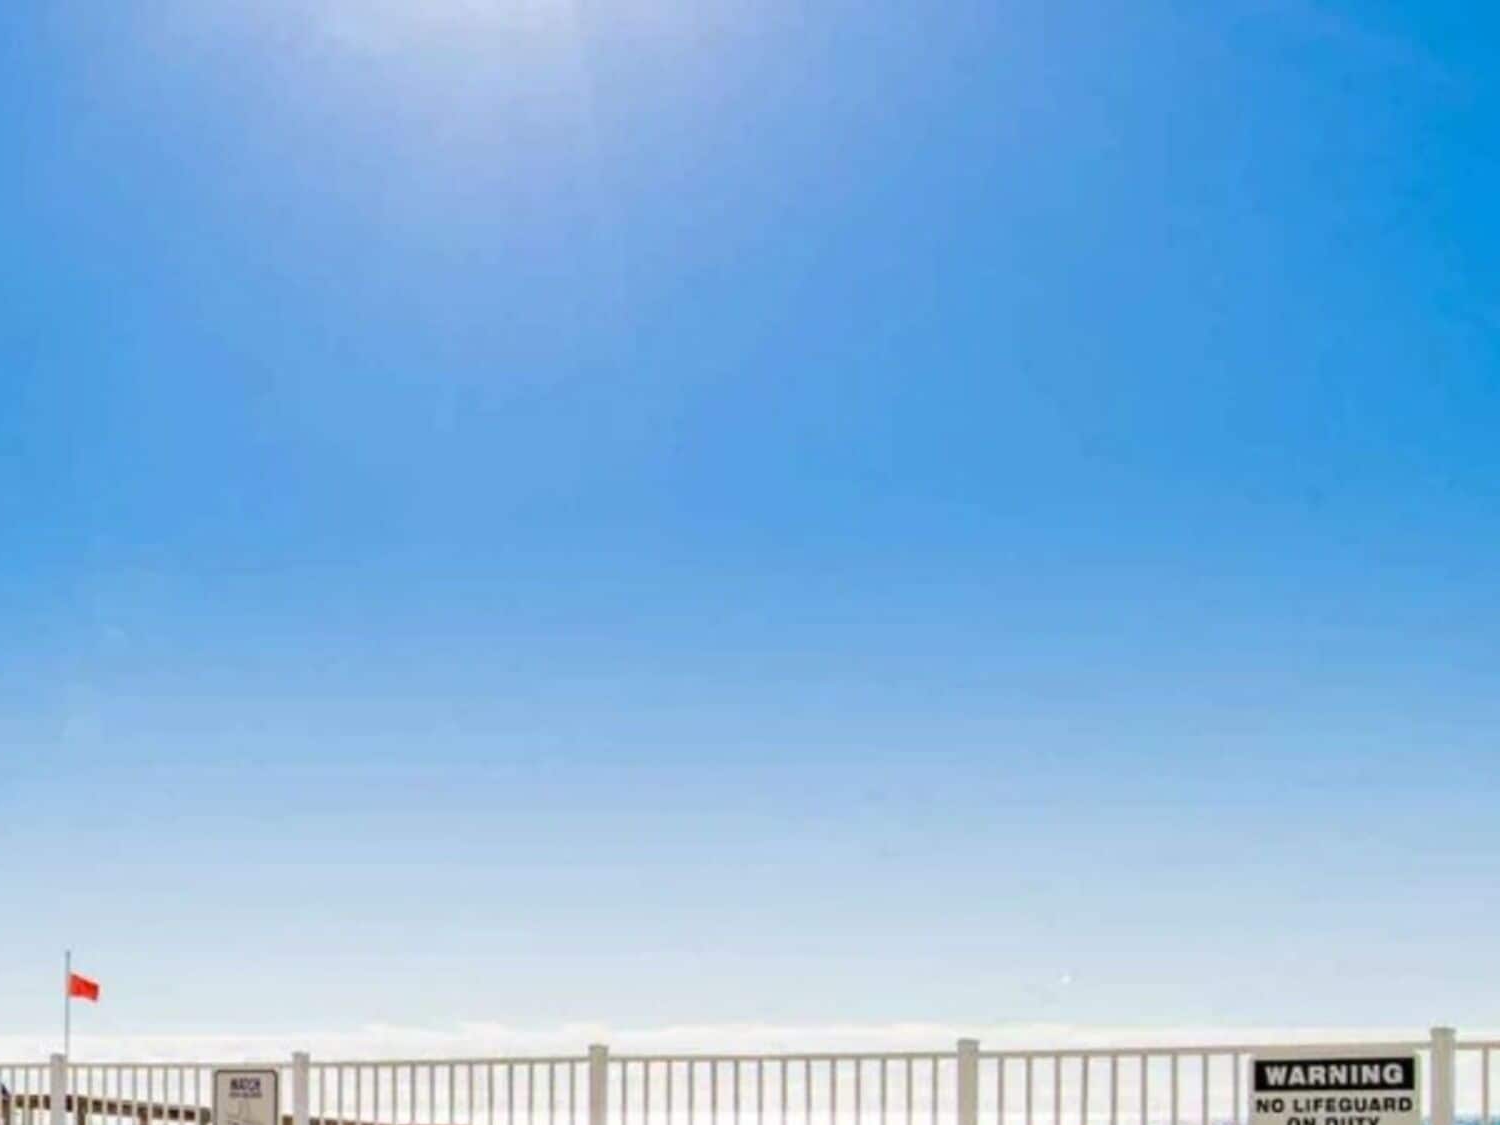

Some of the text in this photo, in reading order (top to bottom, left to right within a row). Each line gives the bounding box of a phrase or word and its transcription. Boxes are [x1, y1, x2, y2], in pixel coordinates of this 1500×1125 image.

[1265, 1063, 1404, 1086] WARNING
[1256, 1097, 1413, 1113] NO LIFEGUARD
